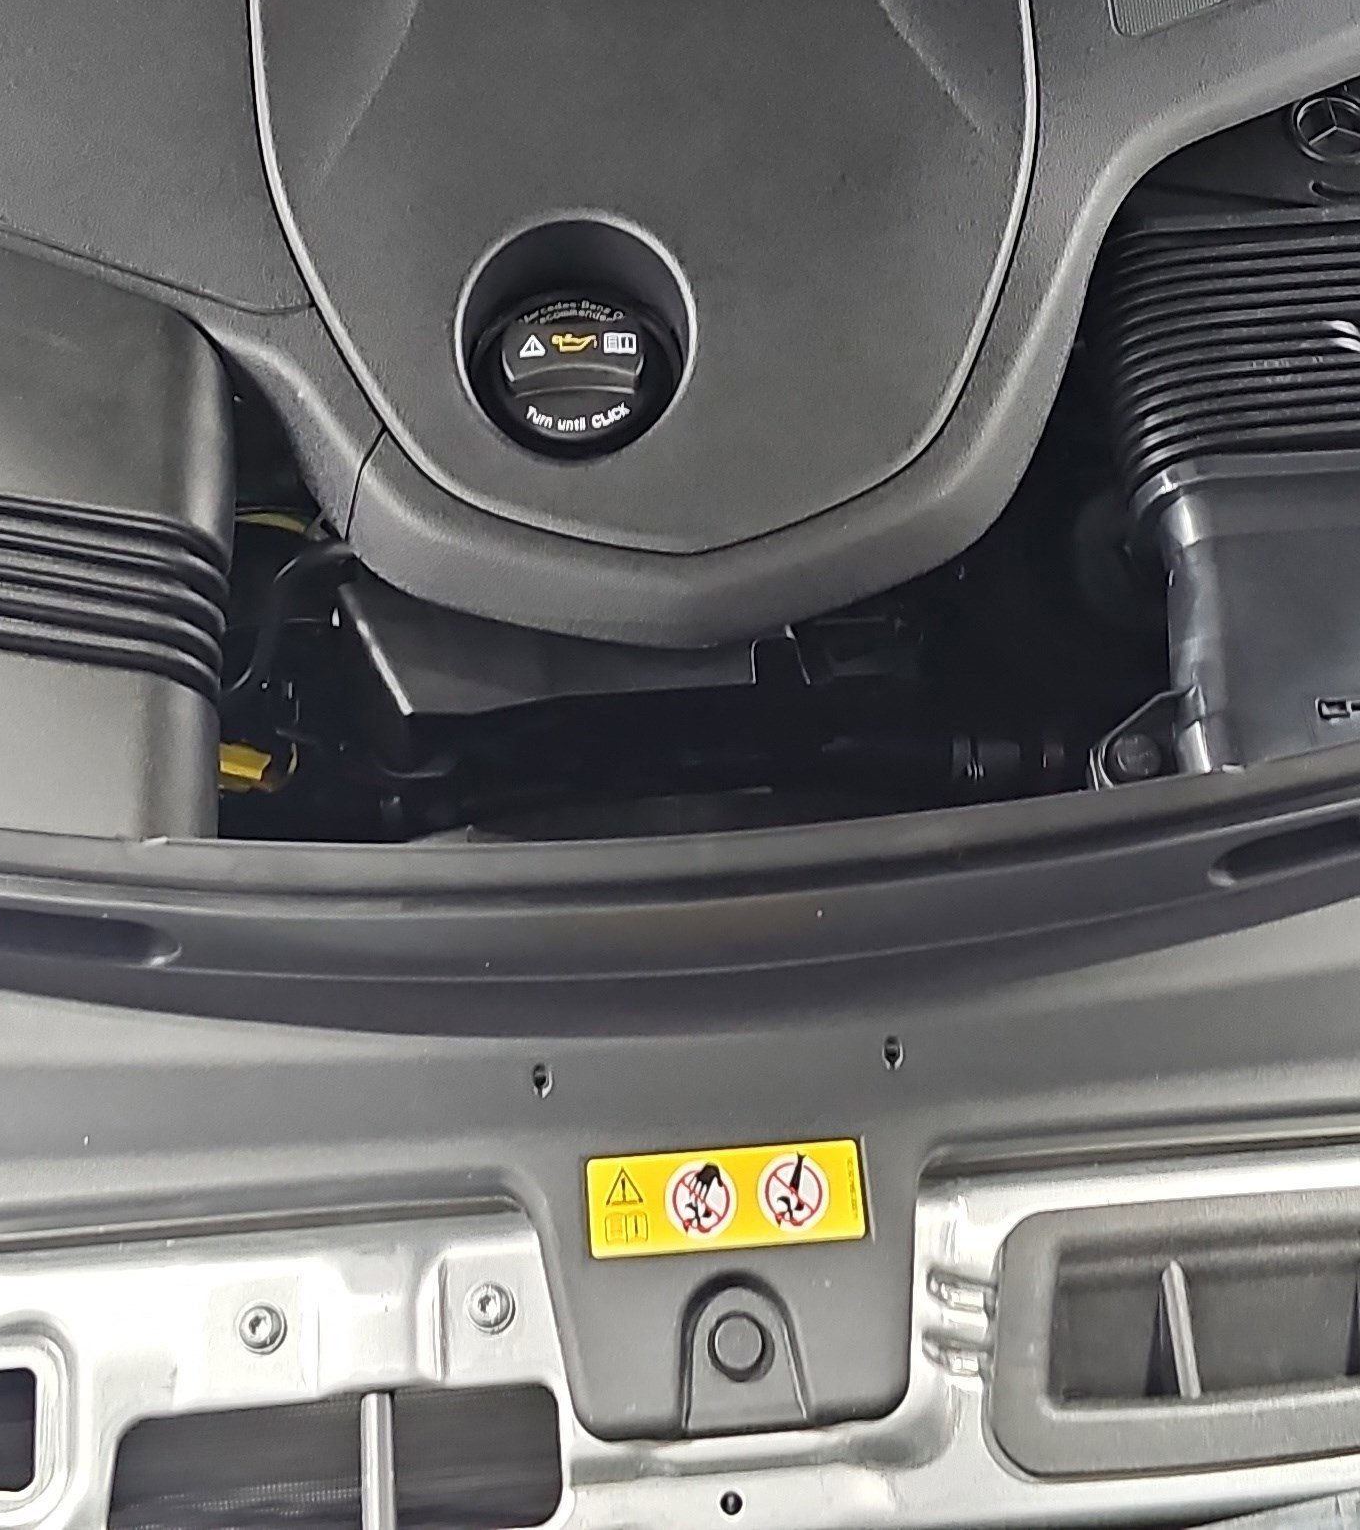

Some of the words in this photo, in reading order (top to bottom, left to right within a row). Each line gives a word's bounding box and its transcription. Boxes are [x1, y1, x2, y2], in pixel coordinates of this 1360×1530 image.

[526, 405, 553, 429] Turn
[557, 416, 586, 432] until
[591, 401, 631, 429] CLICK
